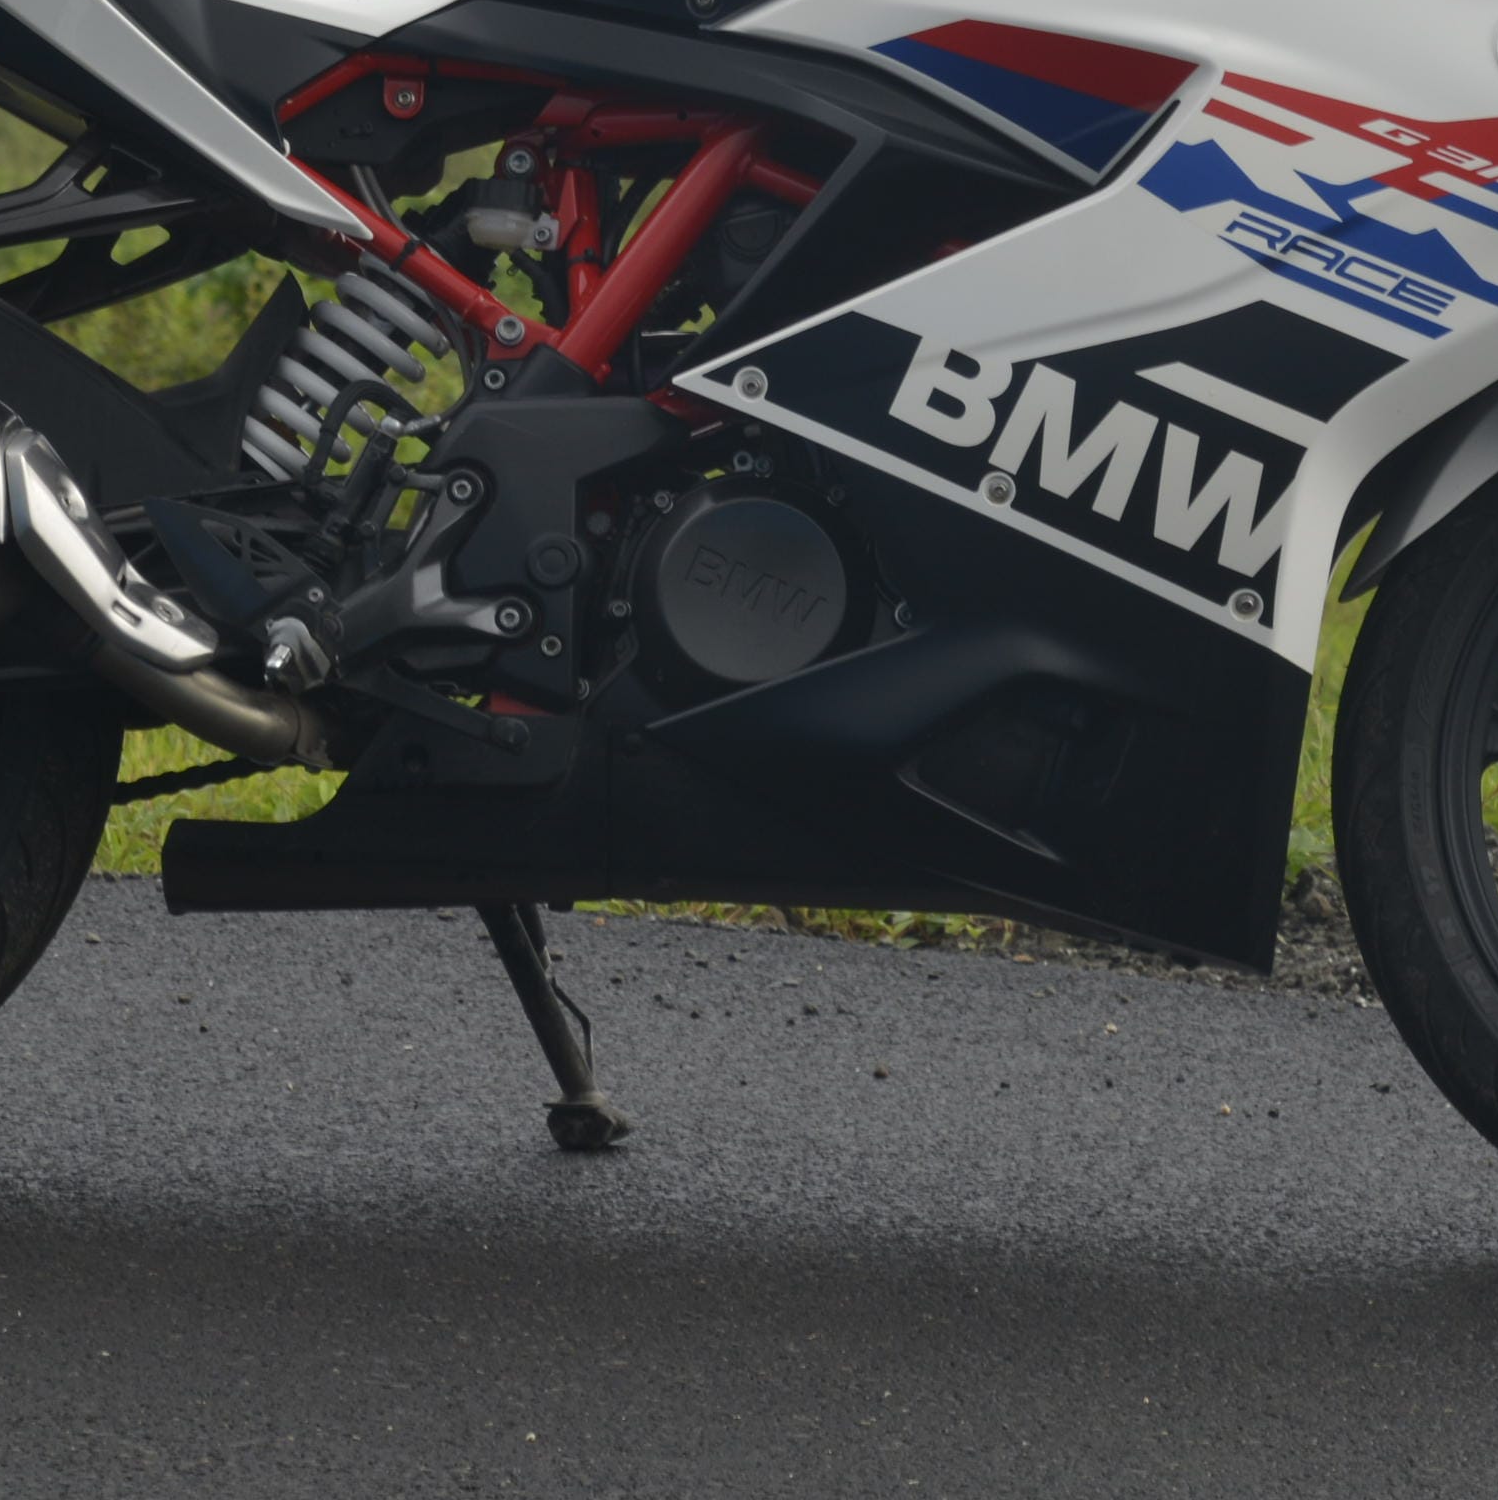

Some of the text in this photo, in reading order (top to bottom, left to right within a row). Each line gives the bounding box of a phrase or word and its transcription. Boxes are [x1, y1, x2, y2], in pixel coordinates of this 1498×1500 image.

[1359, 117, 1431, 148] G
[1223, 210, 1457, 317] RACE
[887, 335, 1303, 578] BMW
[684, 544, 828, 631] BMW
